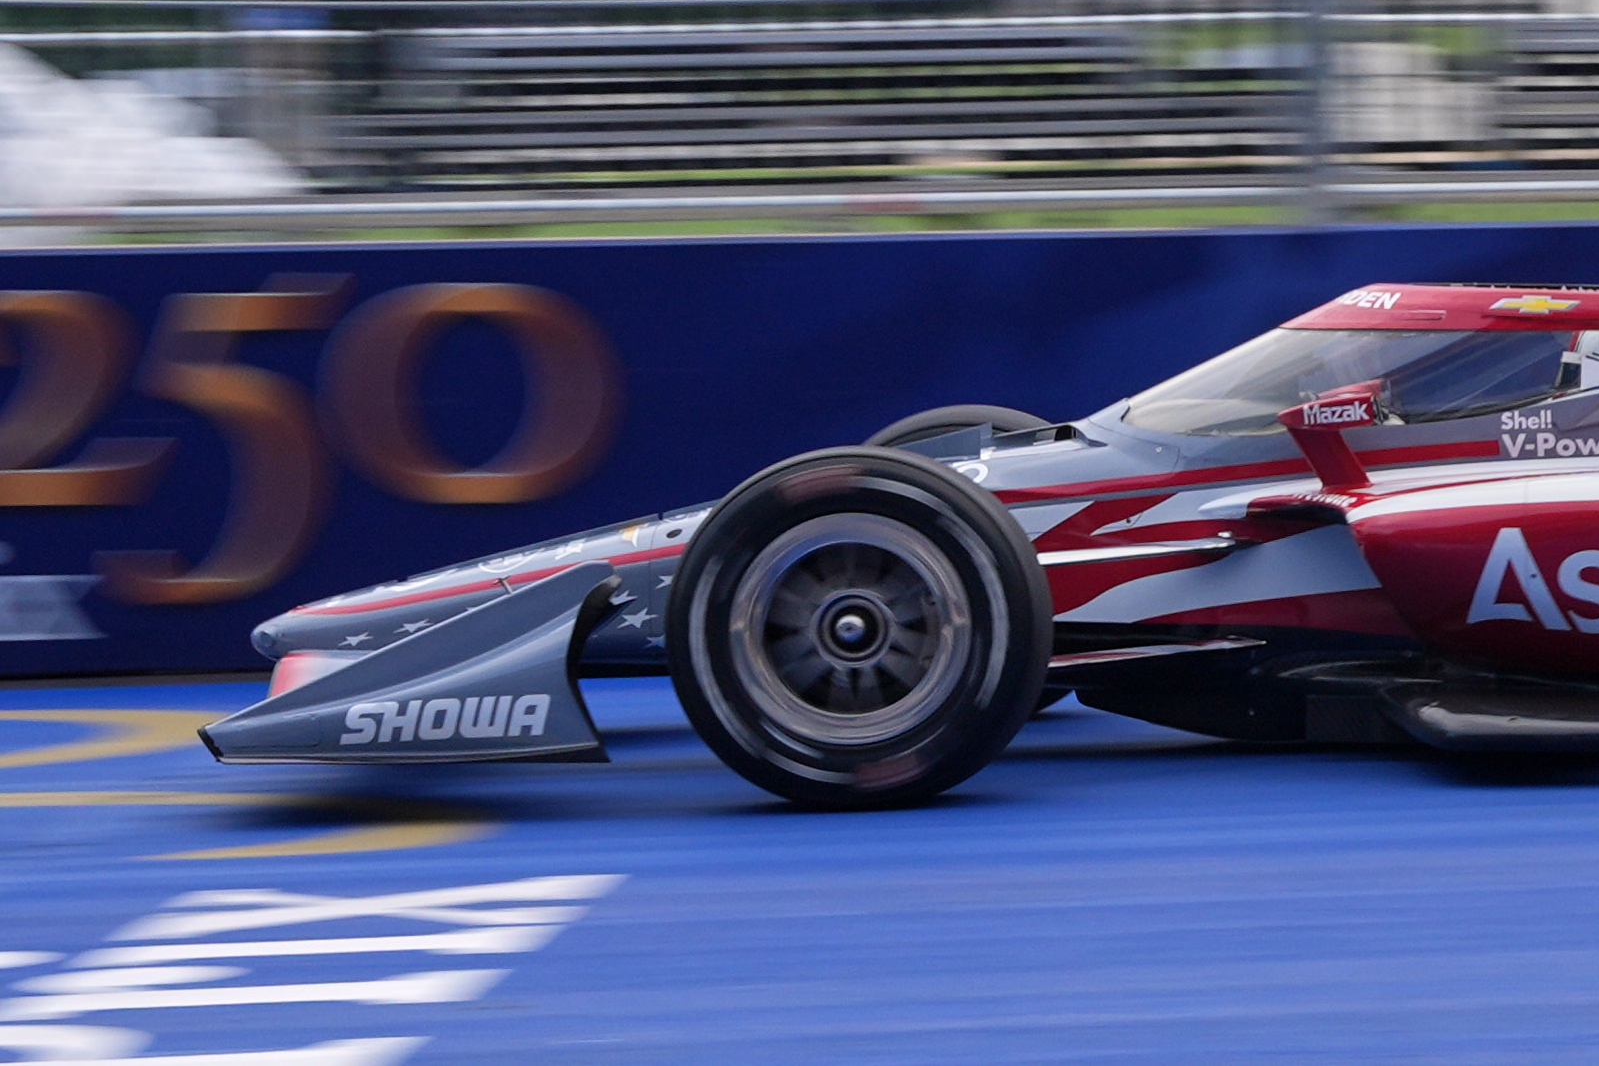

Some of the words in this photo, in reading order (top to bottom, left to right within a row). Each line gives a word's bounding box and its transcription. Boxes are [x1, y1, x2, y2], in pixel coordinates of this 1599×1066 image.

[1336, 289, 1403, 310] DEN
[1302, 401, 1370, 425] Mazak
[1501, 409, 1552, 430] Shell
[0, 273, 624, 605] 250
[339, 693, 551, 745] SHOWA
